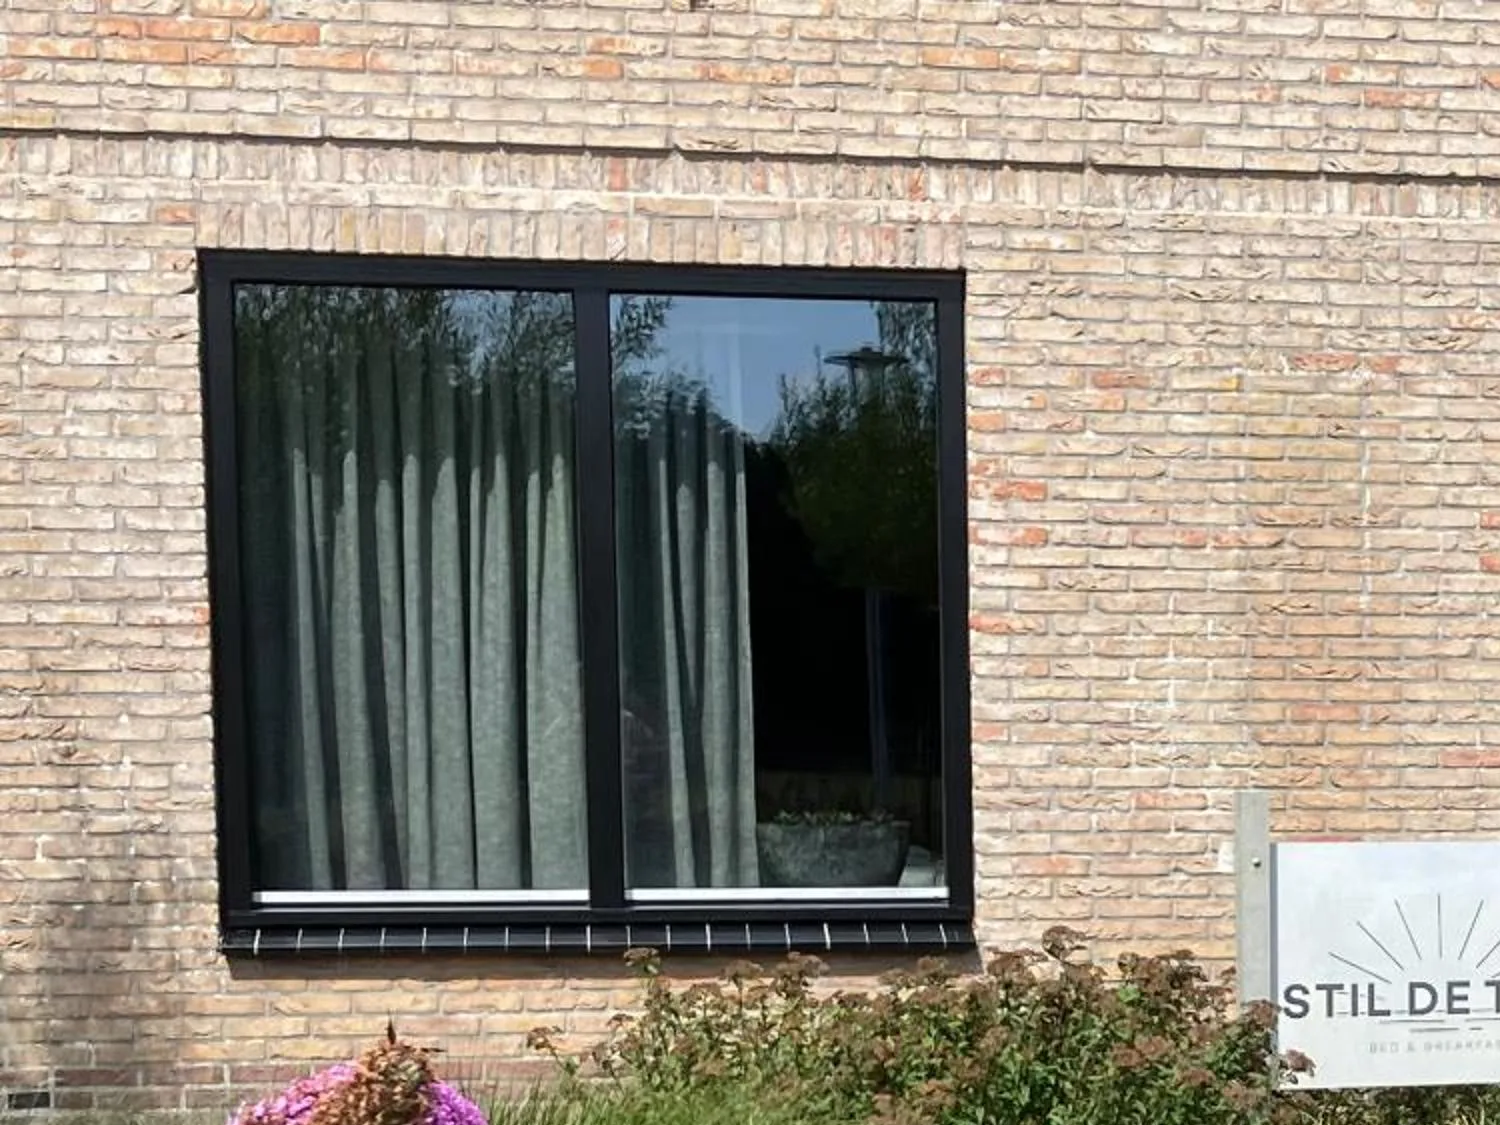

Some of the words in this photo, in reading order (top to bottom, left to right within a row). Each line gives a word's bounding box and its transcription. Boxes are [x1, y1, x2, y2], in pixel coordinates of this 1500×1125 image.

[1282, 982, 1392, 1019] STIL
[1408, 980, 1471, 1016] DE
[1369, 1041, 1400, 1054] BED
